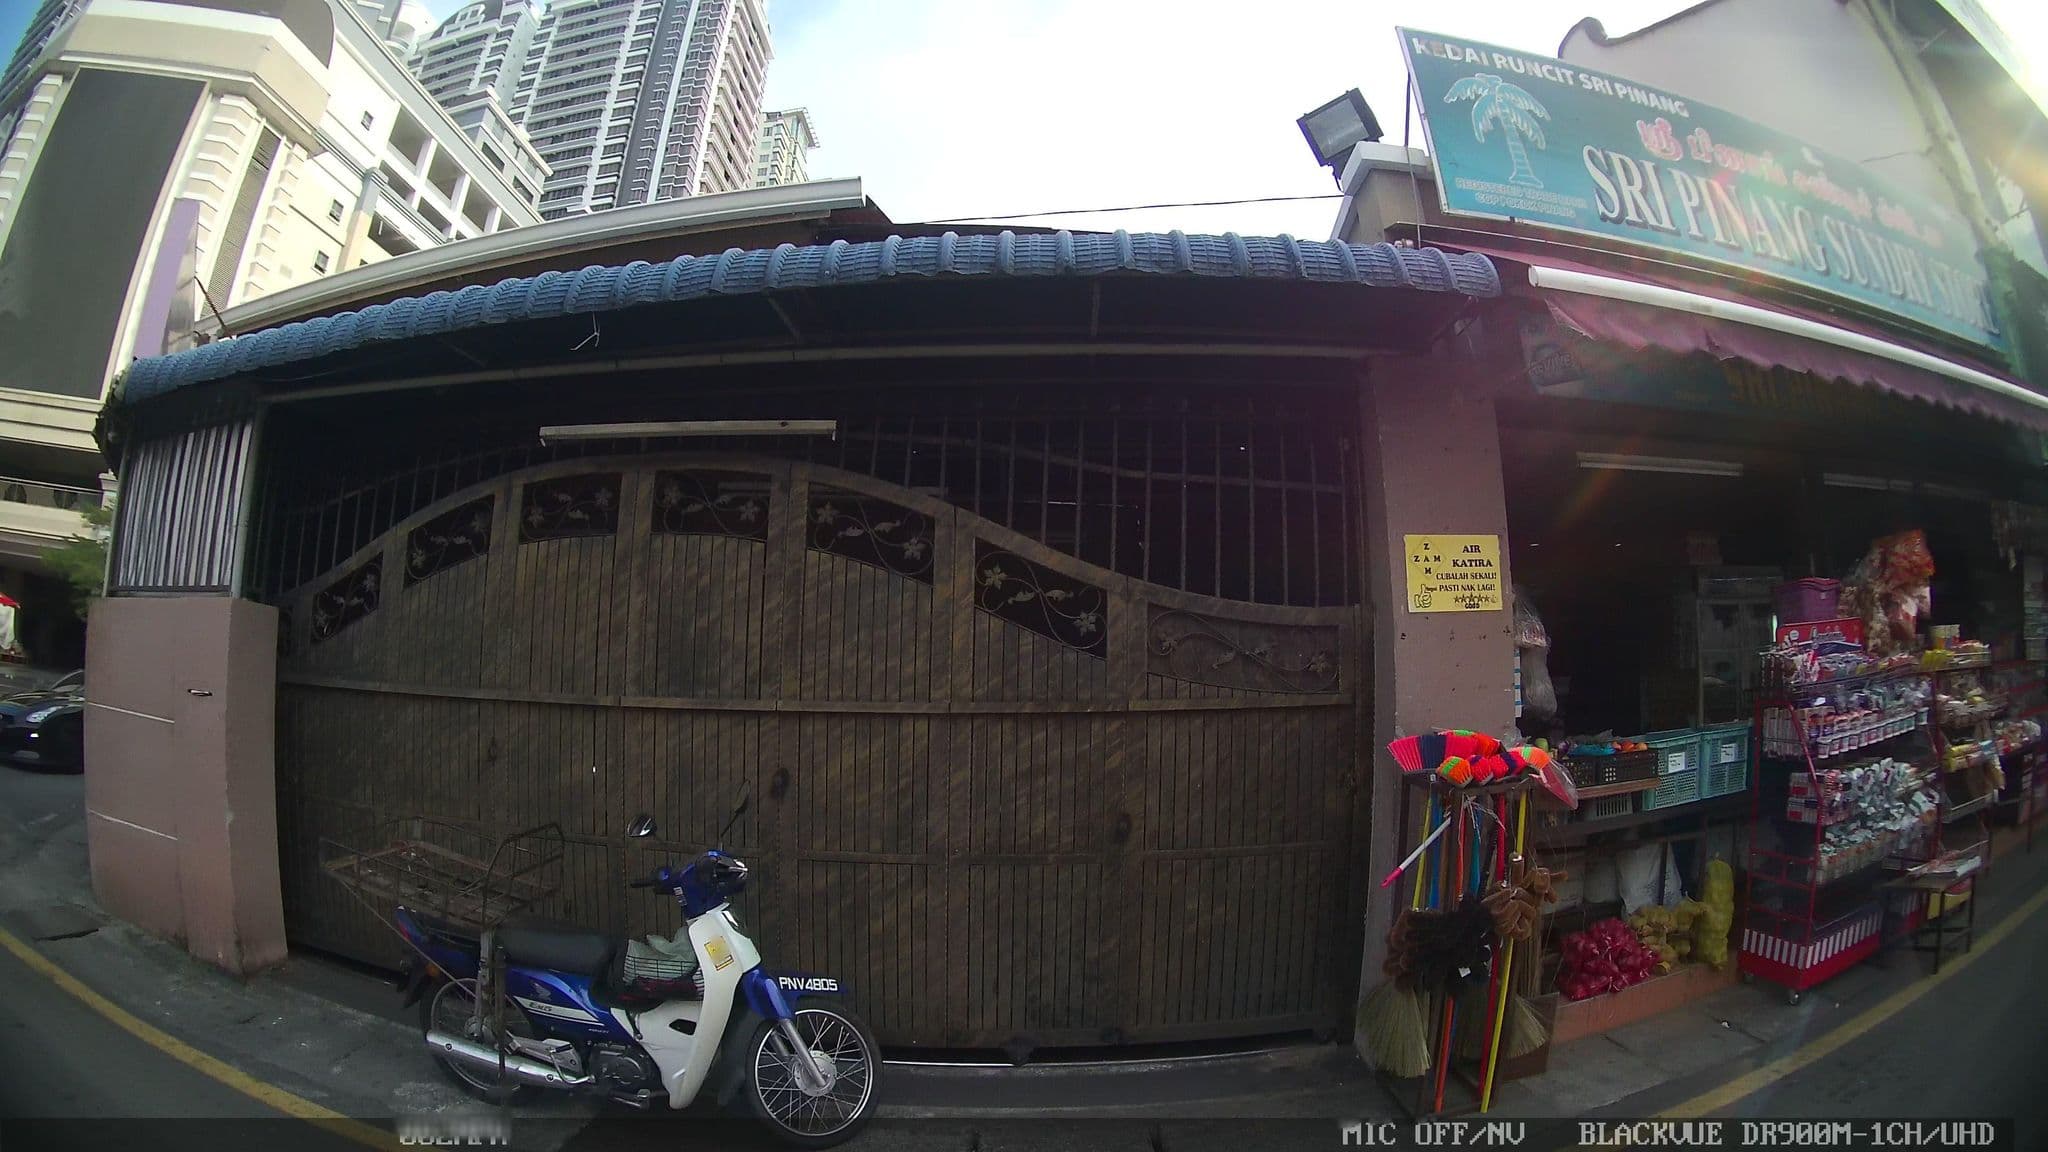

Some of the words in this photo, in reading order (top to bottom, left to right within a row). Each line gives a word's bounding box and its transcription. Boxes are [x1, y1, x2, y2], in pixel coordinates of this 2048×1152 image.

[1412, 38, 1488, 66] KEDAI
[1492, 53, 1574, 85] RUNCIT
[1579, 73, 1613, 96] SRI
[1617, 83, 1690, 117] PINANG
[1583, 144, 1678, 231] SRI
[1667, 167, 1828, 274] PINANG
[1823, 215, 1936, 308] SUNDRY
[1423, 543, 1430, 551] Z
[1462, 545, 1481, 553] AIR
[1452, 559, 1493, 568] KATIRA
[778, 976, 839, 992] PNV4805
